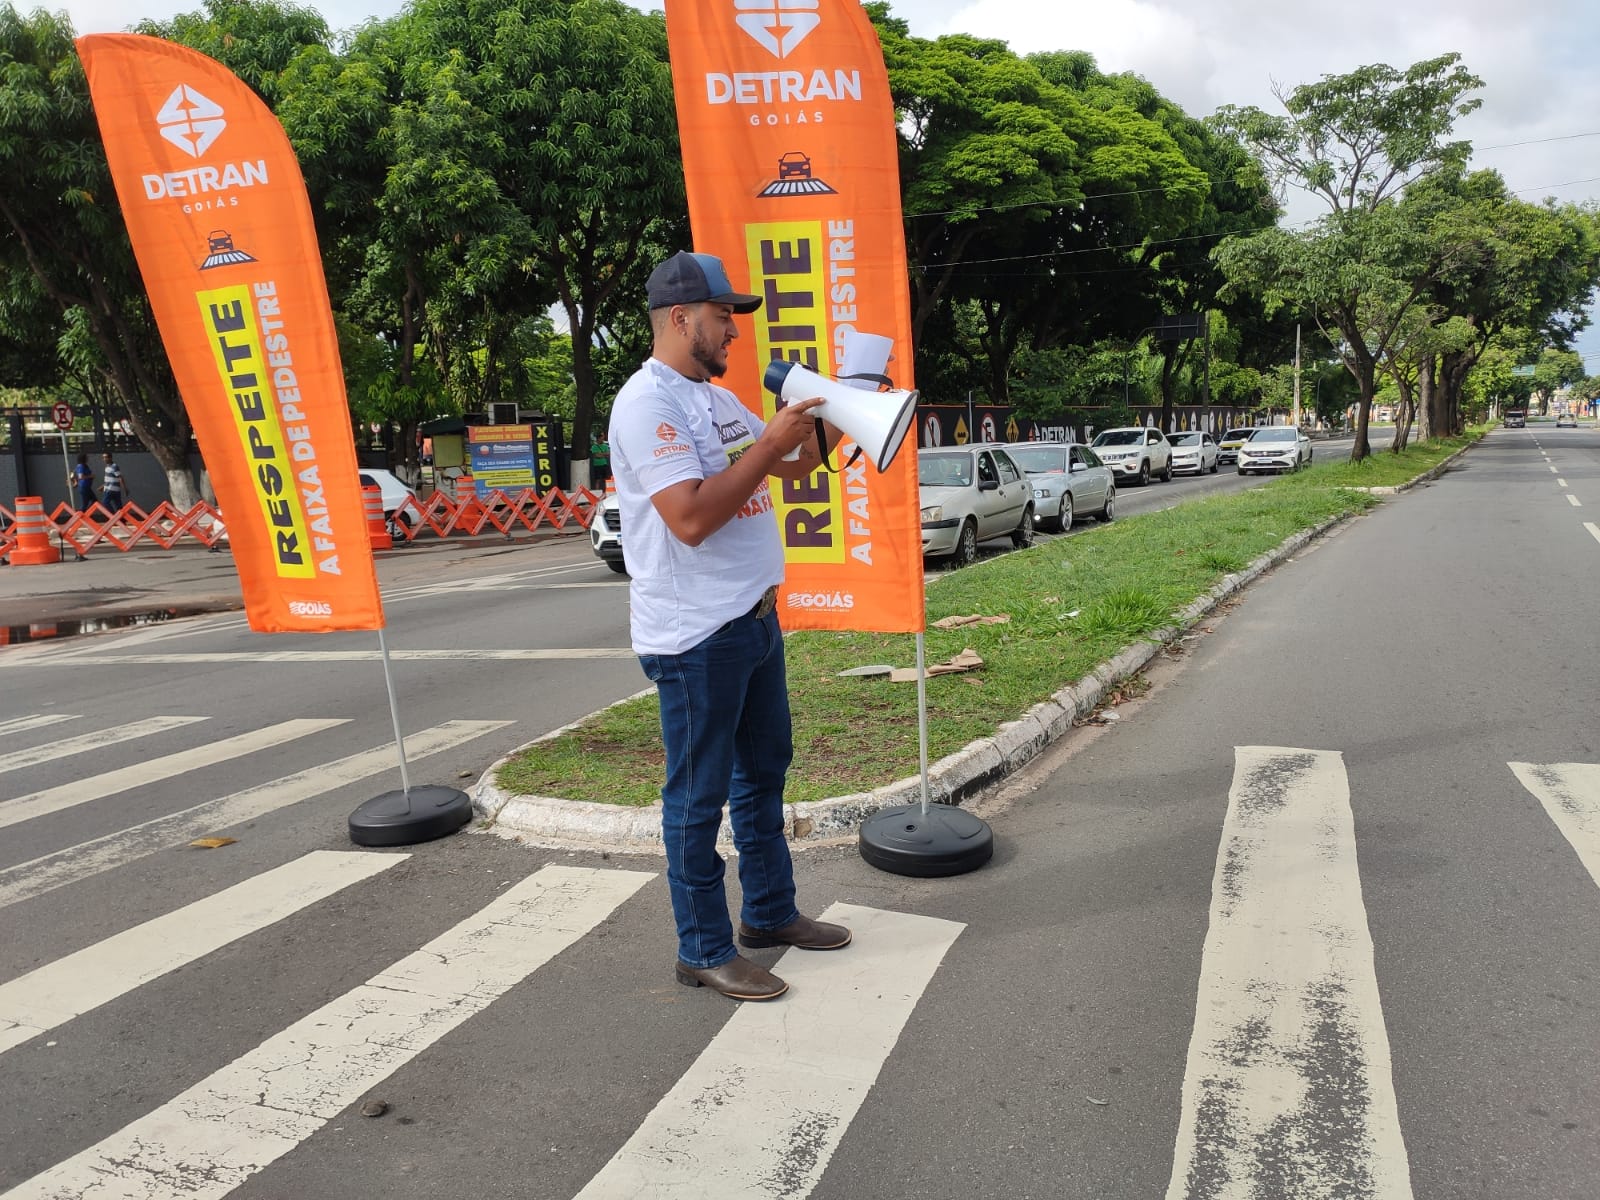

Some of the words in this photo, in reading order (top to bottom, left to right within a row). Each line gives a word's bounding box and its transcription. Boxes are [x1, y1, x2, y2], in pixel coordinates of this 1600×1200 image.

[705, 69, 862, 105] DETRAN
[750, 110, 824, 126] GOIÁS
[141, 160, 269, 200] DETRAN
[183, 196, 238, 214] GOIÁS
[253, 280, 307, 422] PEDESTRE
[760, 238, 833, 548] REITE
[210, 299, 303, 565] RESPEITE
[286, 425, 317, 462] DE
[1041, 425, 1077, 444] DETRAN
[843, 441, 873, 536] FAIXA
[298, 465, 337, 551] FAIXA
[319, 555, 342, 575] A
[851, 542, 873, 567] A
[800, 591, 854, 608] GOIÁS
